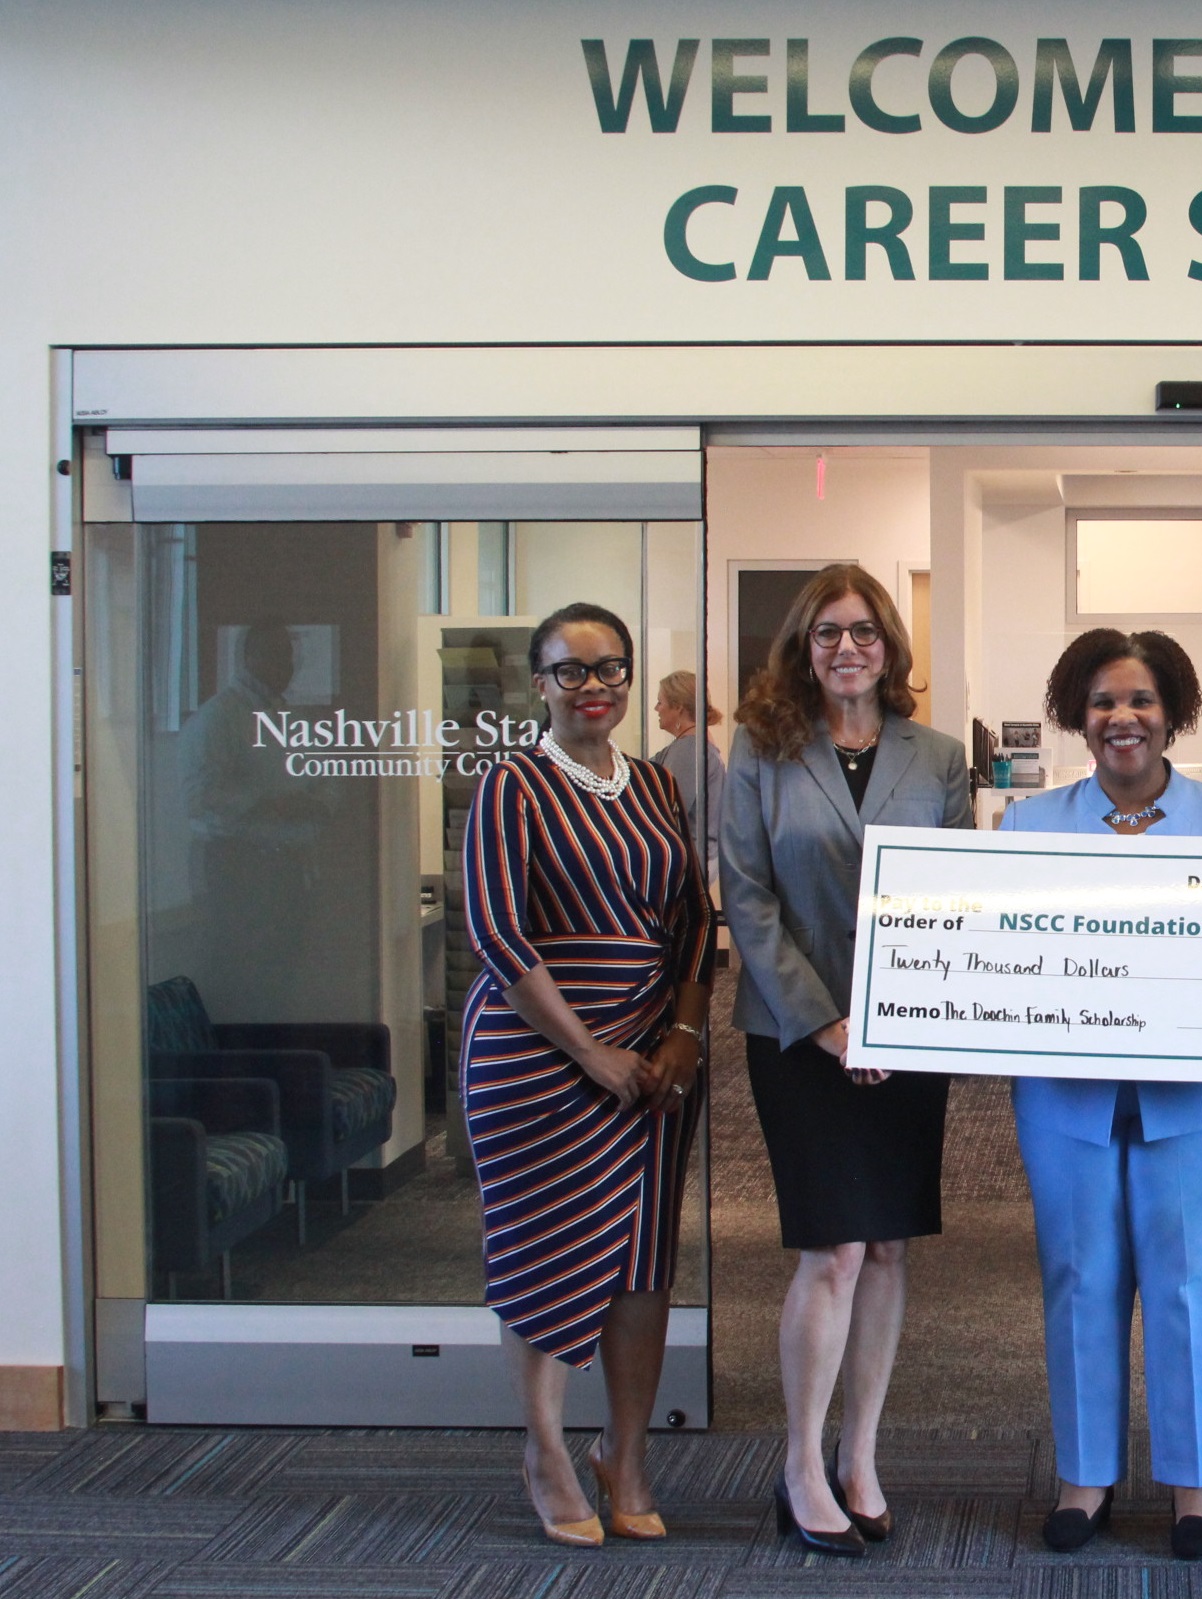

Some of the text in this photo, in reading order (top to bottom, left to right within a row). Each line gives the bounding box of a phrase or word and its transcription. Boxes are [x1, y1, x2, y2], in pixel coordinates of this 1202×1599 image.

[663, 185, 1150, 282] CAREER
[252, 708, 539, 748] Nashville Sta
[285, 752, 451, 783] Community
[878, 914, 937, 931] Order
[943, 916, 964, 931] of
[999, 913, 1065, 932] NSCC
[882, 945, 950, 980] Twenty
[963, 952, 1043, 975] Thousand
[1064, 957, 1129, 978] Dollars
[877, 1002, 941, 1019] Memo
[941, 1001, 967, 1020] The
[1026, 1006, 1070, 1033] Family
[1080, 1010, 1147, 1032] Scholarship
